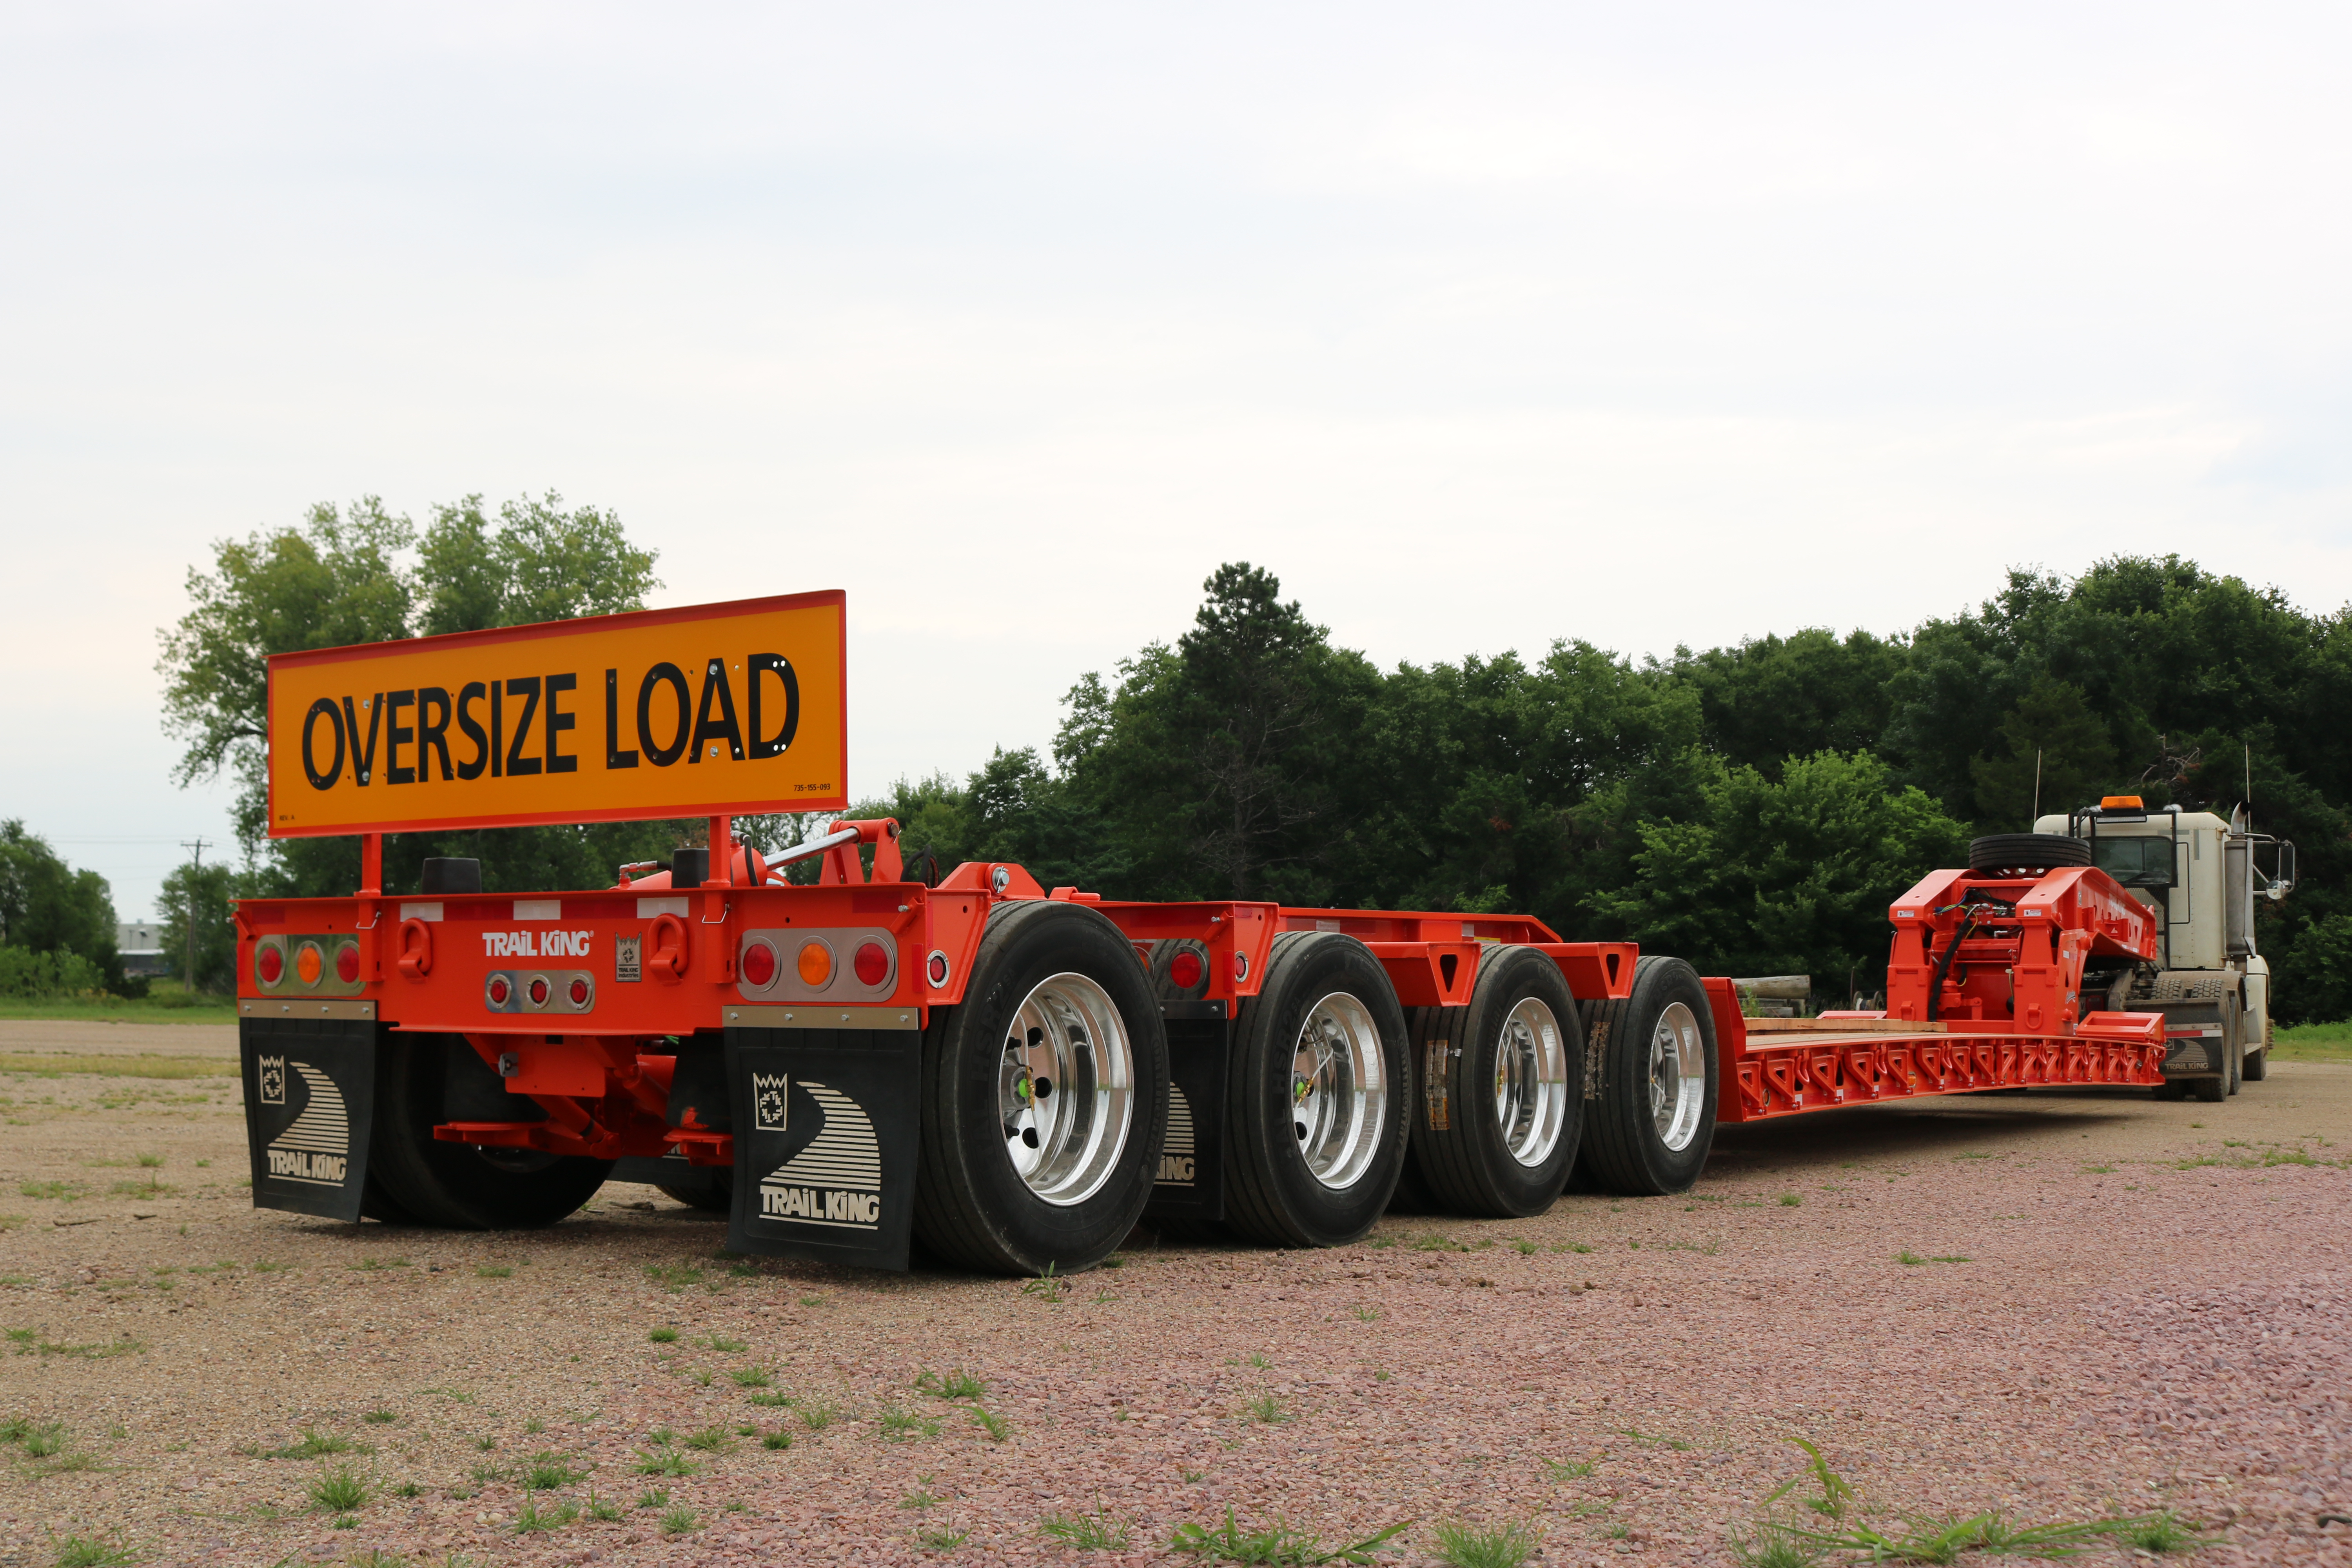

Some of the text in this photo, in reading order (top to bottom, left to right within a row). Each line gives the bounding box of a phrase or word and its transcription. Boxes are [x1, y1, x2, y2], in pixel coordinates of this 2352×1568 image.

[302, 652, 800, 791] OVERSIZE LOAD
[793, 783, 831, 791] 735-155-093
